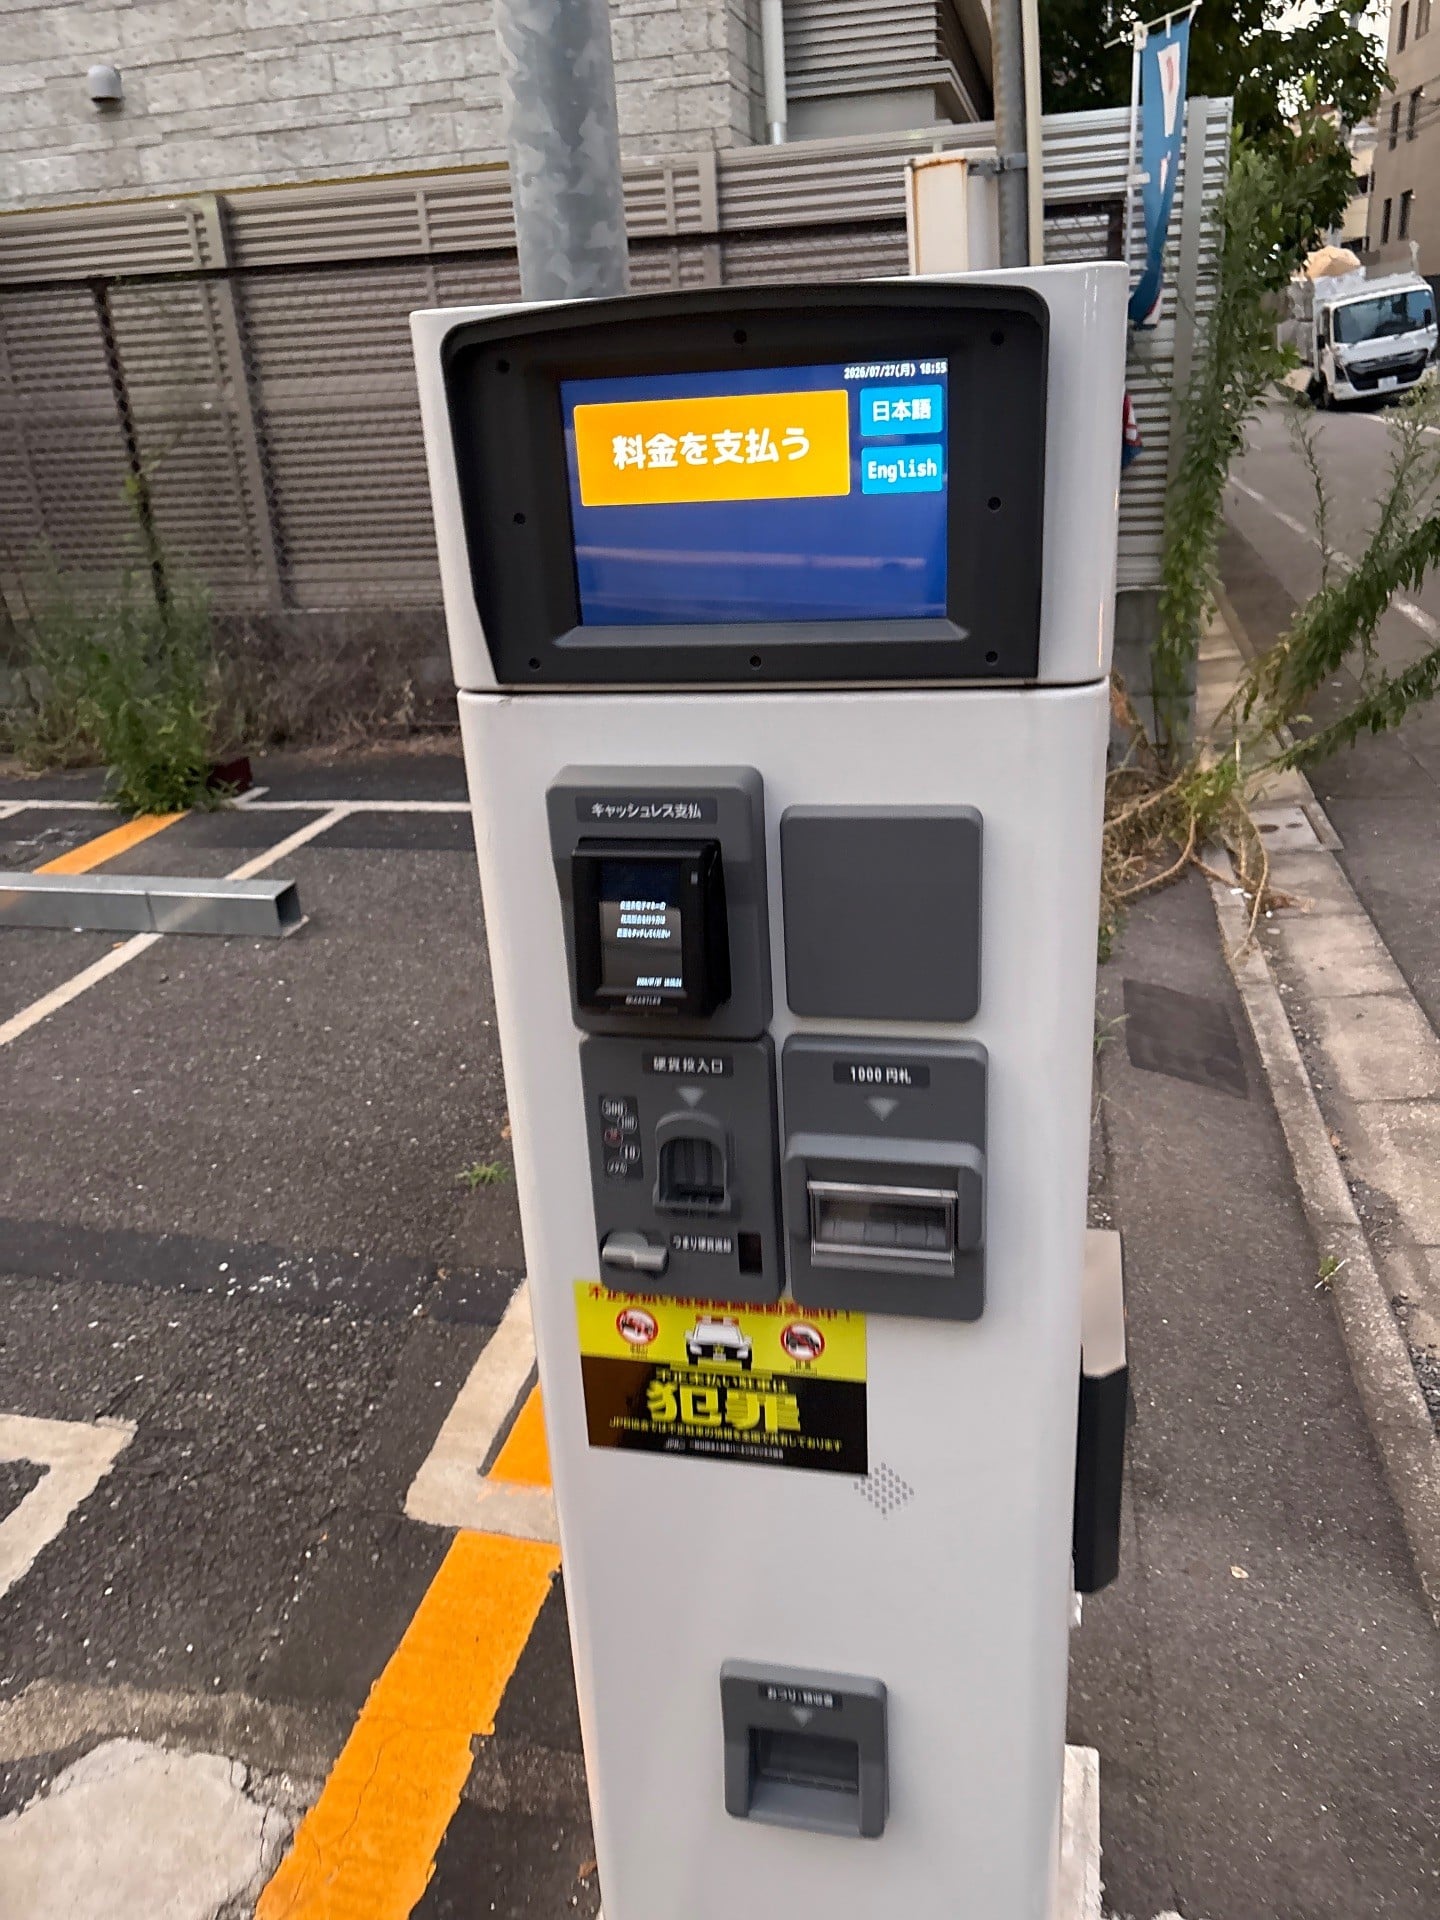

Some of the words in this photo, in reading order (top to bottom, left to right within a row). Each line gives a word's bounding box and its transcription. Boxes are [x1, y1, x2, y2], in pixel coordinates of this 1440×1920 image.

[872, 398, 932, 423] 日本語
[612, 427, 811, 470] 料金を支払う
[868, 459, 938, 484] English
[591, 802, 702, 819] キャッシュレス支払
[653, 1055, 724, 1075] 硬貨投入口
[646, 1380, 801, 1433] 犯罪
